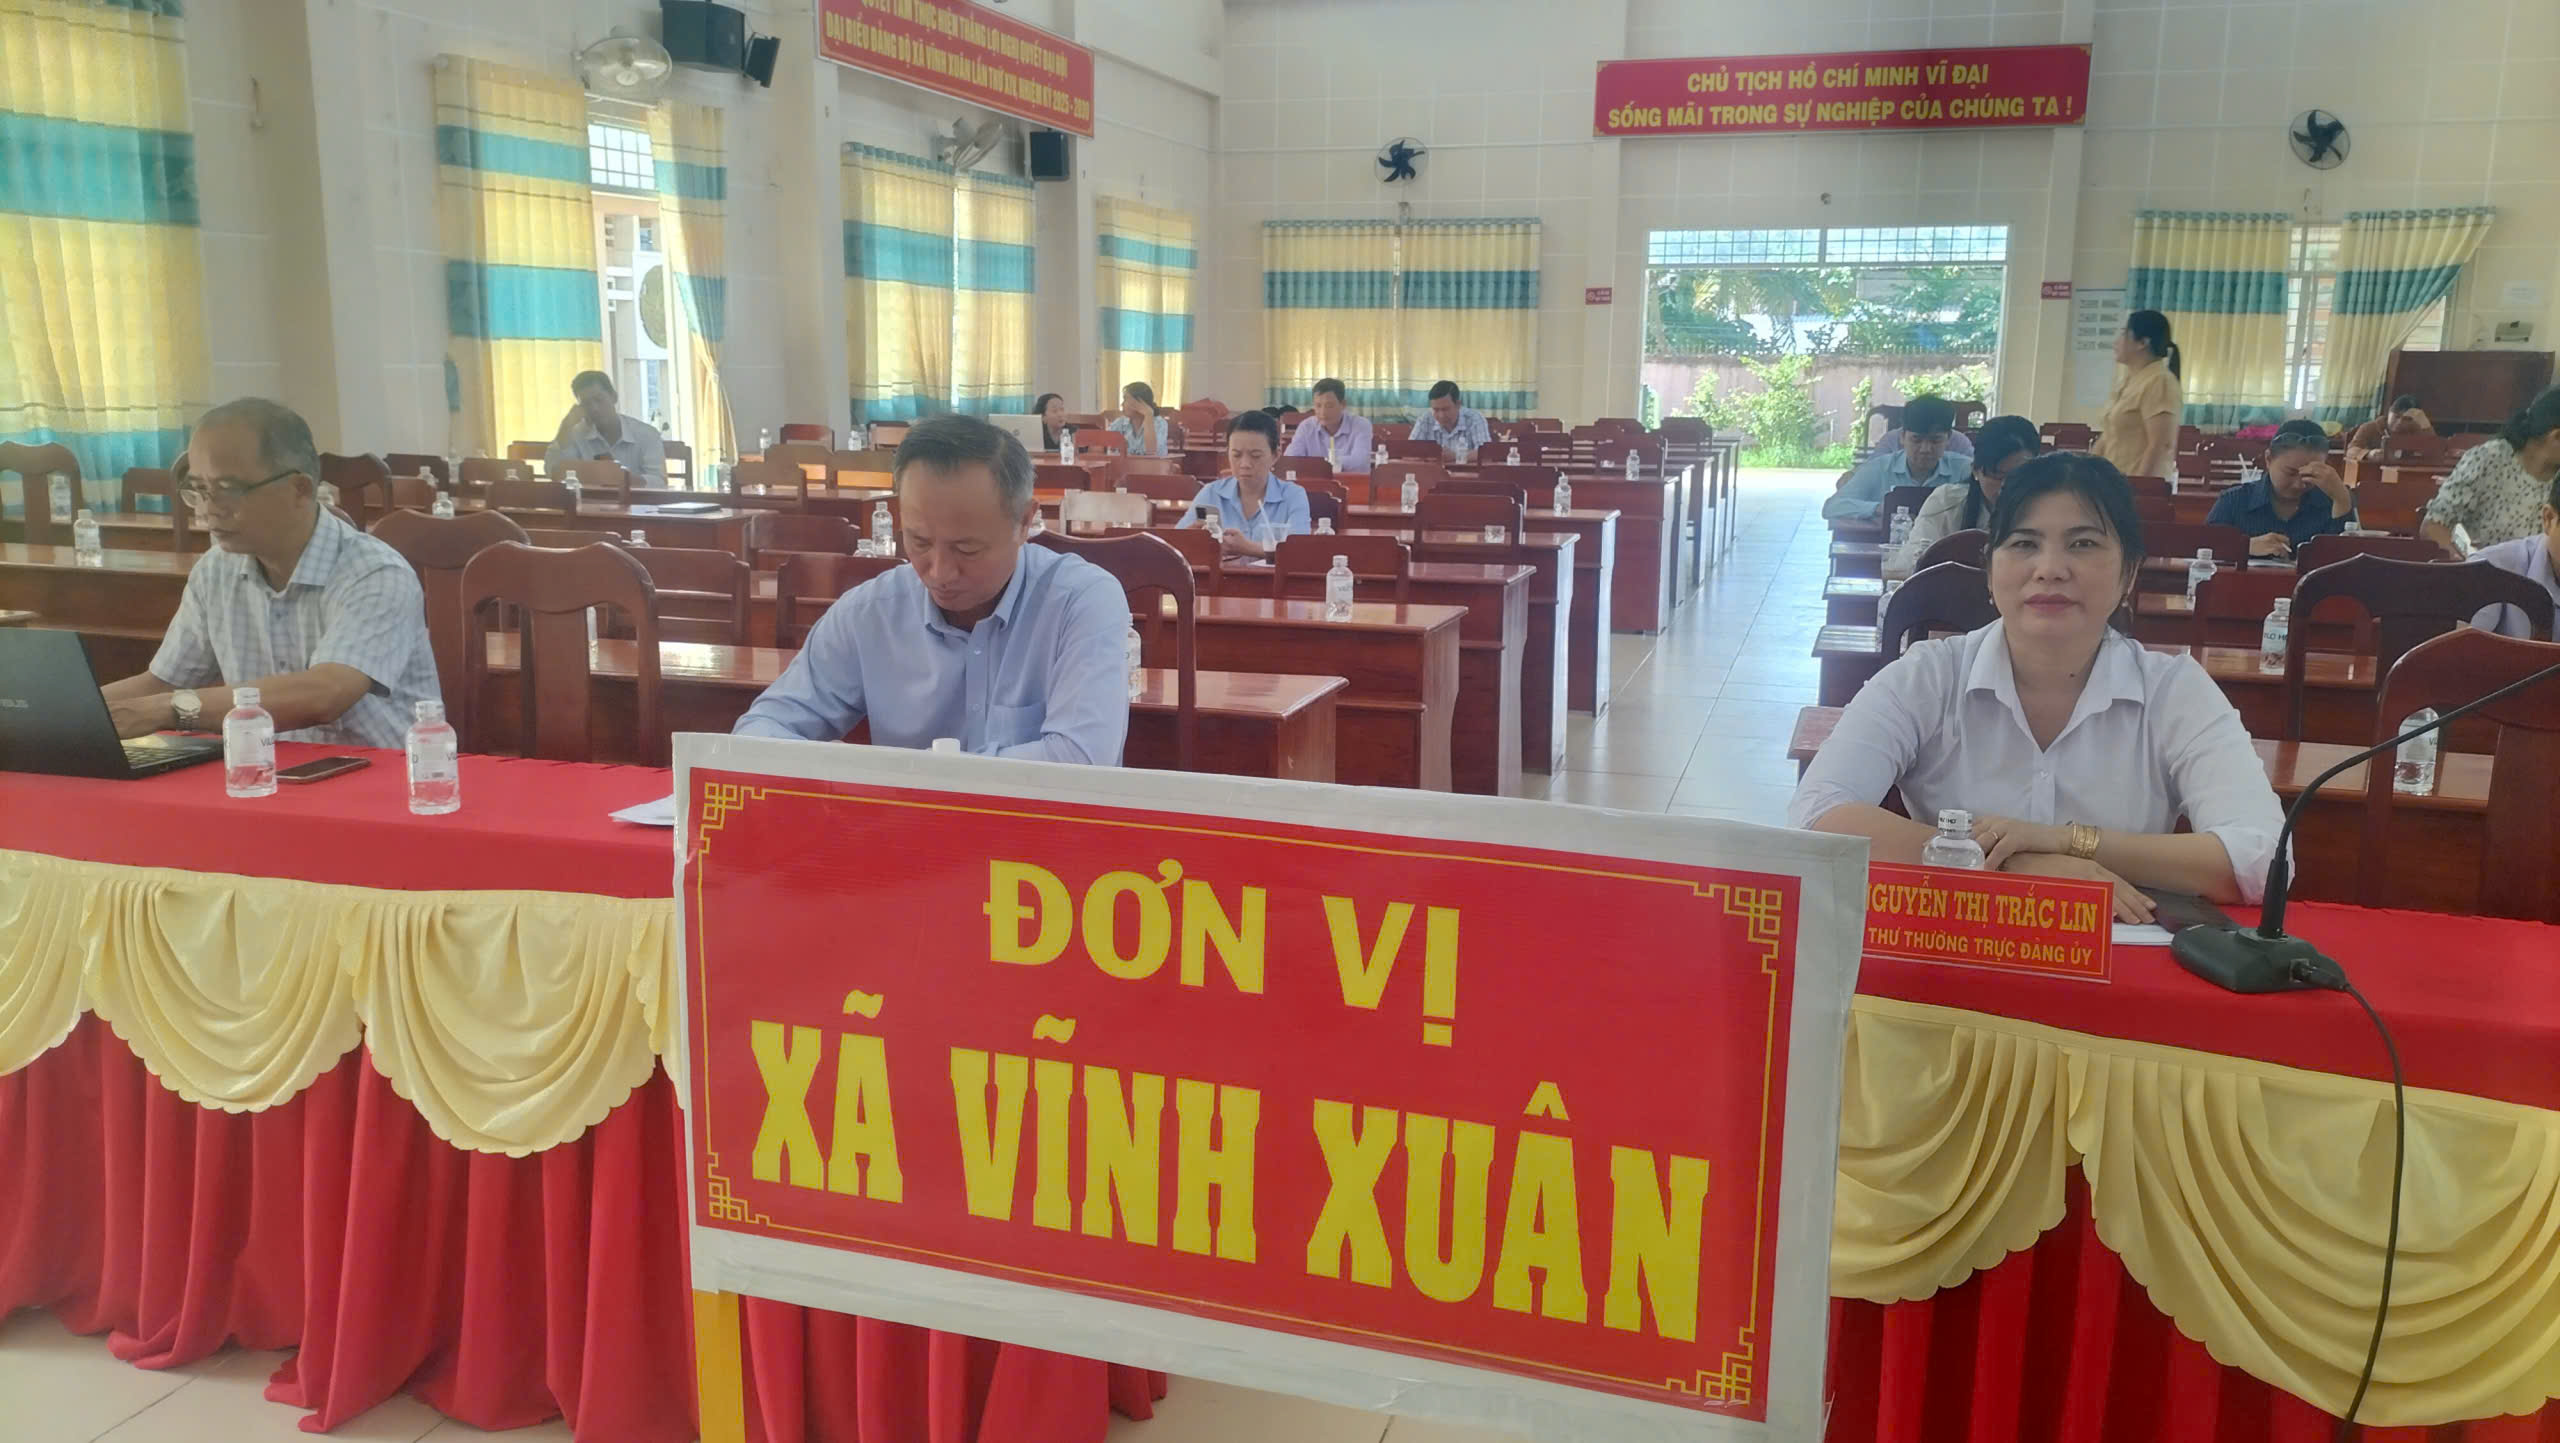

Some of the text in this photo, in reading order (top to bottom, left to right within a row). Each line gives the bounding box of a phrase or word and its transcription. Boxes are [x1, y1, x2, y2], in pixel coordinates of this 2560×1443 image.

[1687, 59, 1990, 97] CHỦ TỊCH HỒ CHÍ MINH VĨ ĐẠI
[1608, 93, 2073, 129] SỐNG MÃI TRONG SỰ NGHIỆP CỦA CHÚNG TA !
[1953, 890, 1990, 929] THỊ
[1995, 884, 2056, 929] TRẮC
[2060, 901, 2098, 933] LIN
[983, 859, 1460, 1047] ĐƠN VỊ
[1868, 926, 2093, 966] THƯ THƯỜNG TRỰC ĐẢNG ỦY
[751, 989, 1711, 1343] XÃ VĨNH XUÂN
